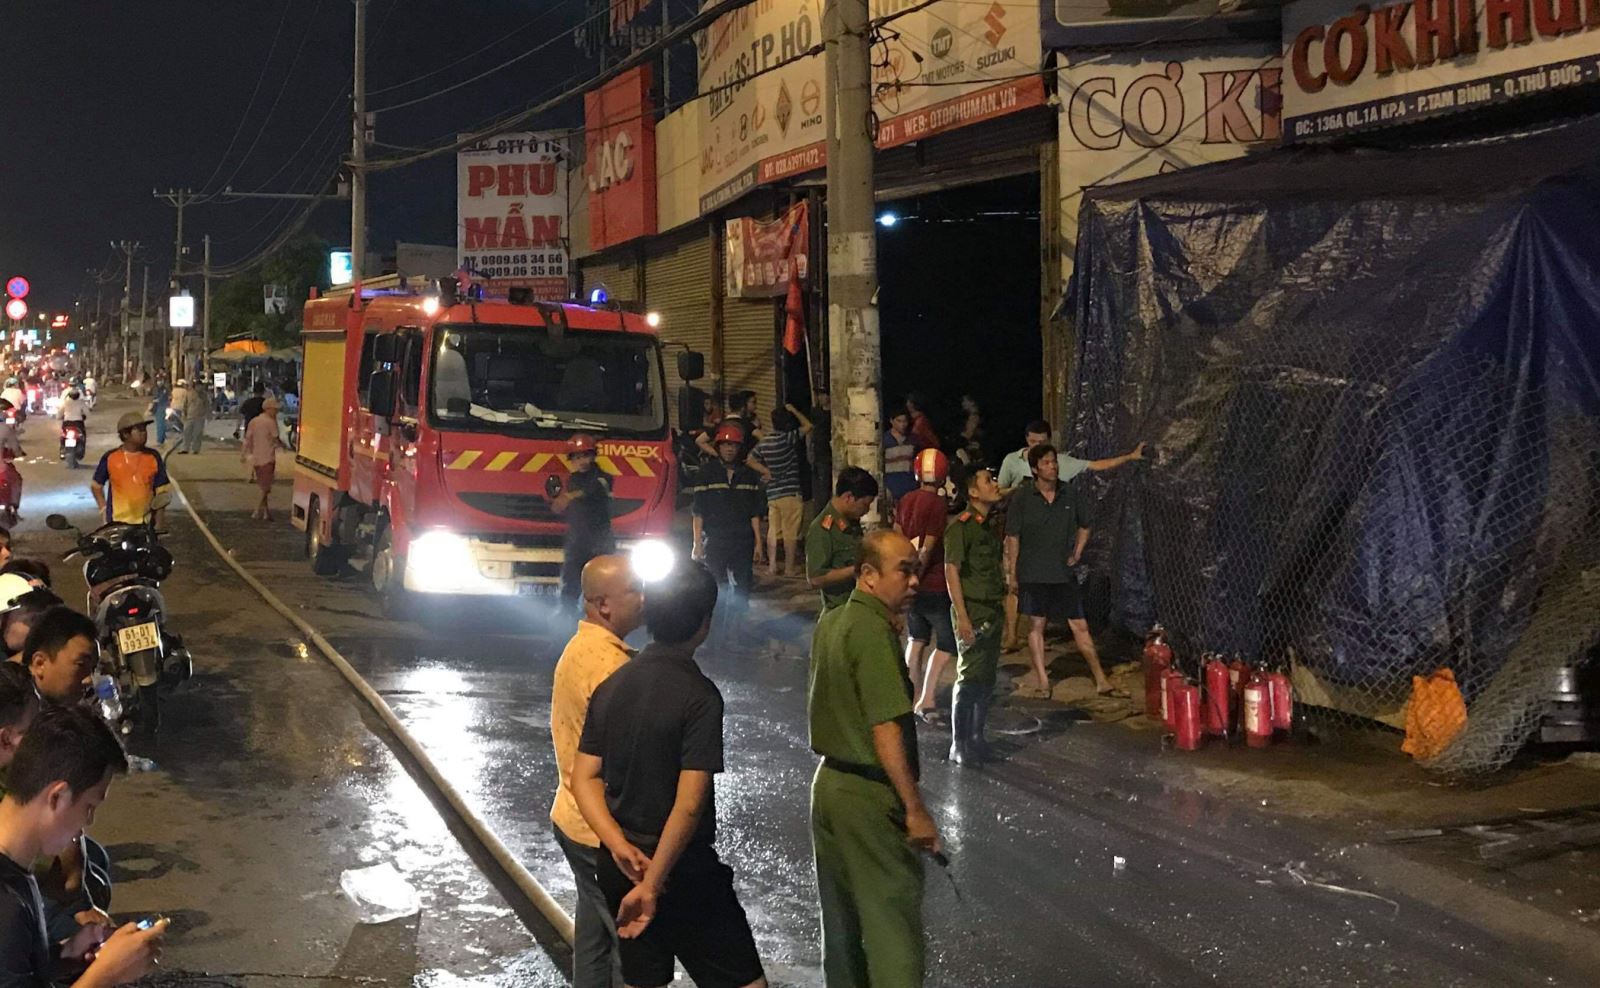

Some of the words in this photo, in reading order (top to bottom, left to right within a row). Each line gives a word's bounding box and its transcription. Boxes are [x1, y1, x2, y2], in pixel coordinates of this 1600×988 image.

[977, 46, 1016, 71] SUZUKI
[1292, 4, 1370, 93] CƠ
[903, 114, 928, 137] WEB:
[930, 87, 1017, 128] OTOPHUMAN.VN
[1068, 61, 1185, 150] CƠ
[801, 115, 822, 130] HINO
[1317, 111, 1343, 133] 136A
[588, 131, 633, 192] JAC
[531, 254, 544, 264] 34
[531, 265, 544, 276] 35
